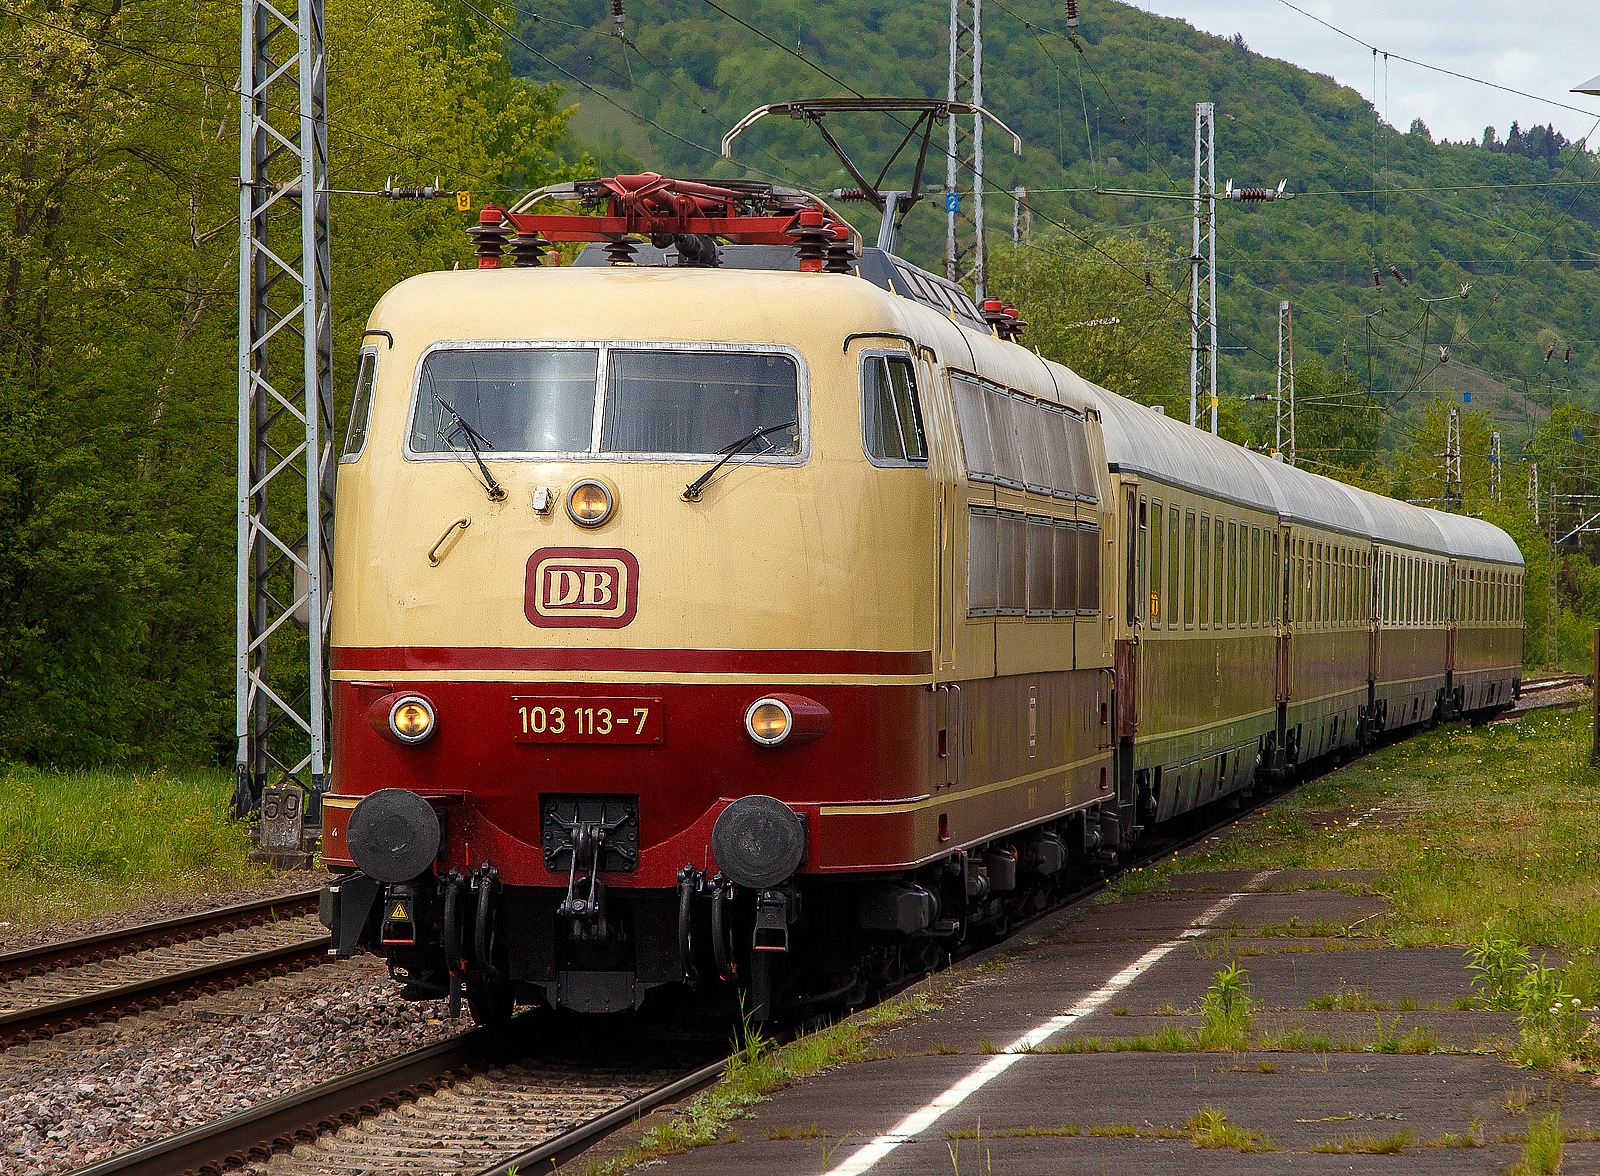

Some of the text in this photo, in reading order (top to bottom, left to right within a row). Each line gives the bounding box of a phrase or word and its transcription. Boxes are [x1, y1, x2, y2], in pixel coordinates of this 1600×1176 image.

[460, 194, 468, 208] 8
[948, 195, 956, 209] 2
[544, 569, 613, 607] DB
[518, 706, 649, 735] 103 113-7
[265, 792, 299, 820] 59
